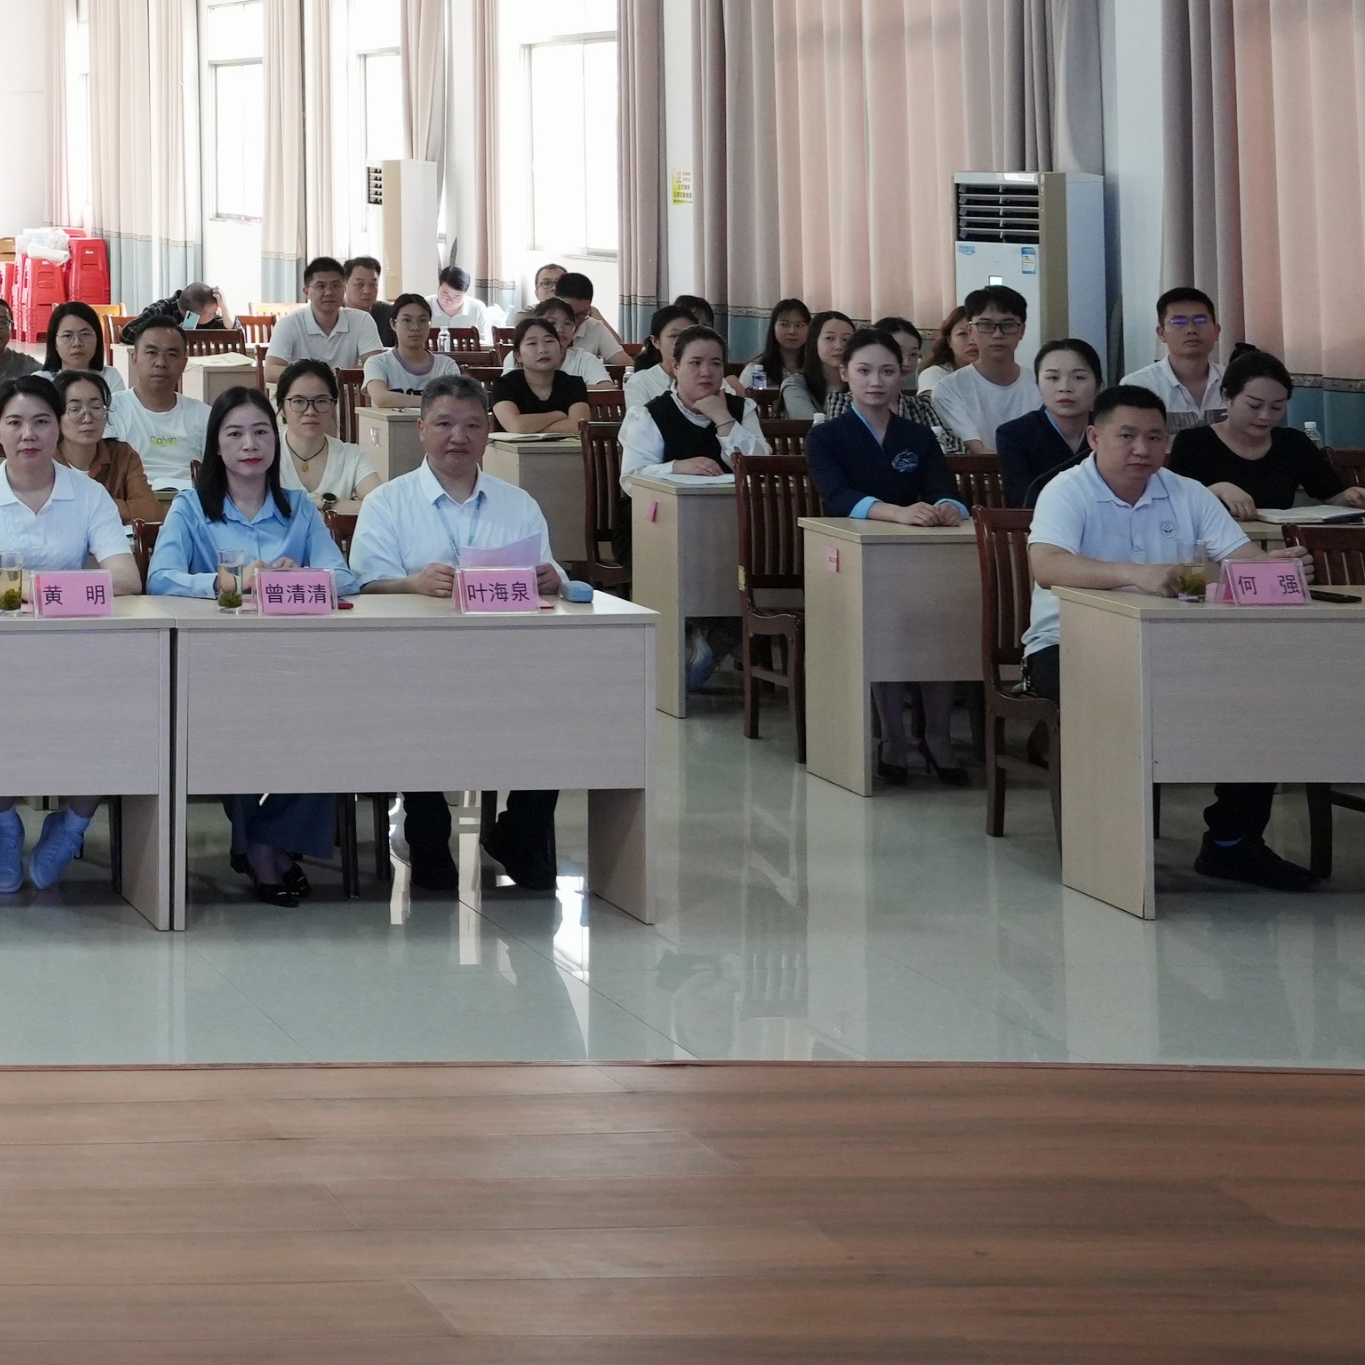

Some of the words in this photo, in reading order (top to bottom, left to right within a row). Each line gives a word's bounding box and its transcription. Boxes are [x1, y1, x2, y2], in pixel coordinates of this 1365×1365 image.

[42, 585, 106, 606] 黄明
[265, 583, 327, 604] 曾清清
[468, 581, 531, 603] 叶海泉
[1237, 574, 1302, 596] 何强
